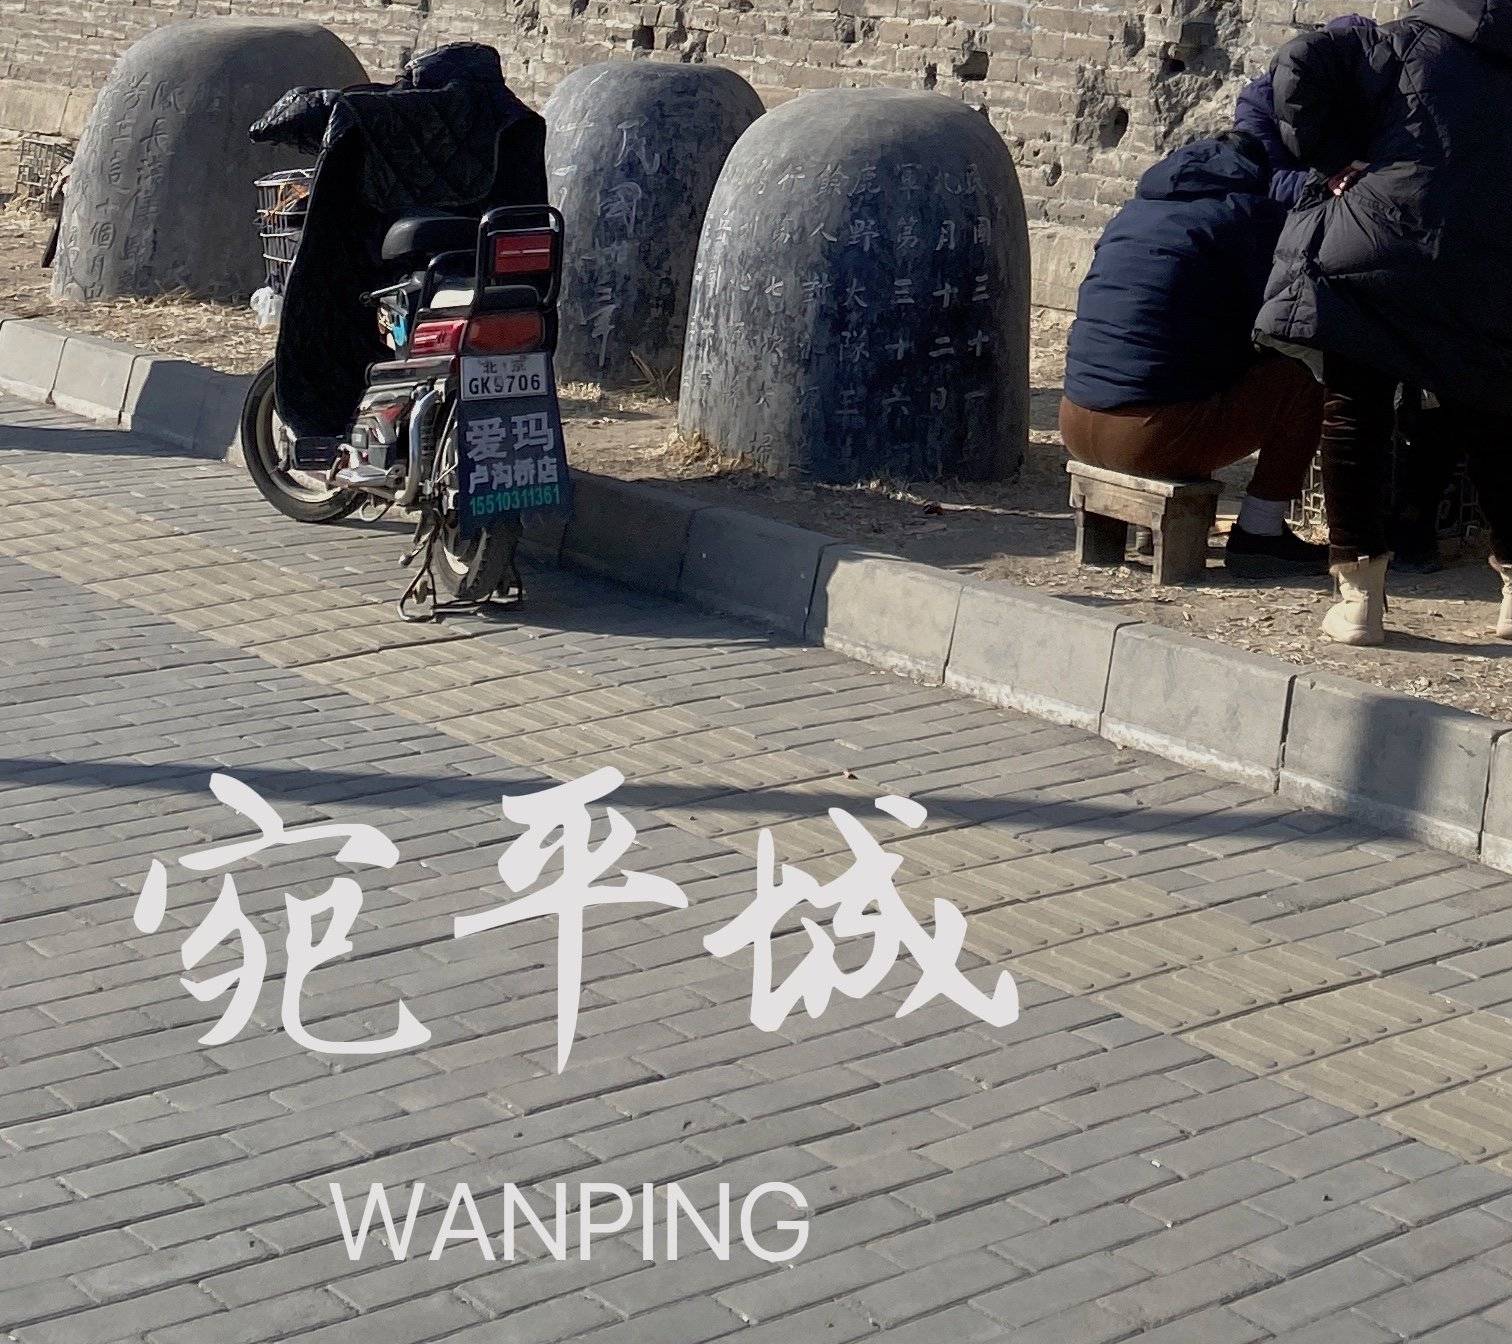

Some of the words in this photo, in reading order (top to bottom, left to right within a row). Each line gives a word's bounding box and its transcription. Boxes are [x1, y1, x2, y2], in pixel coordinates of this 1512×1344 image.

[465, 412, 554, 462] 爱玛
[468, 455, 559, 494] 卢沟桥店
[469, 483, 561, 516] 15510311361
